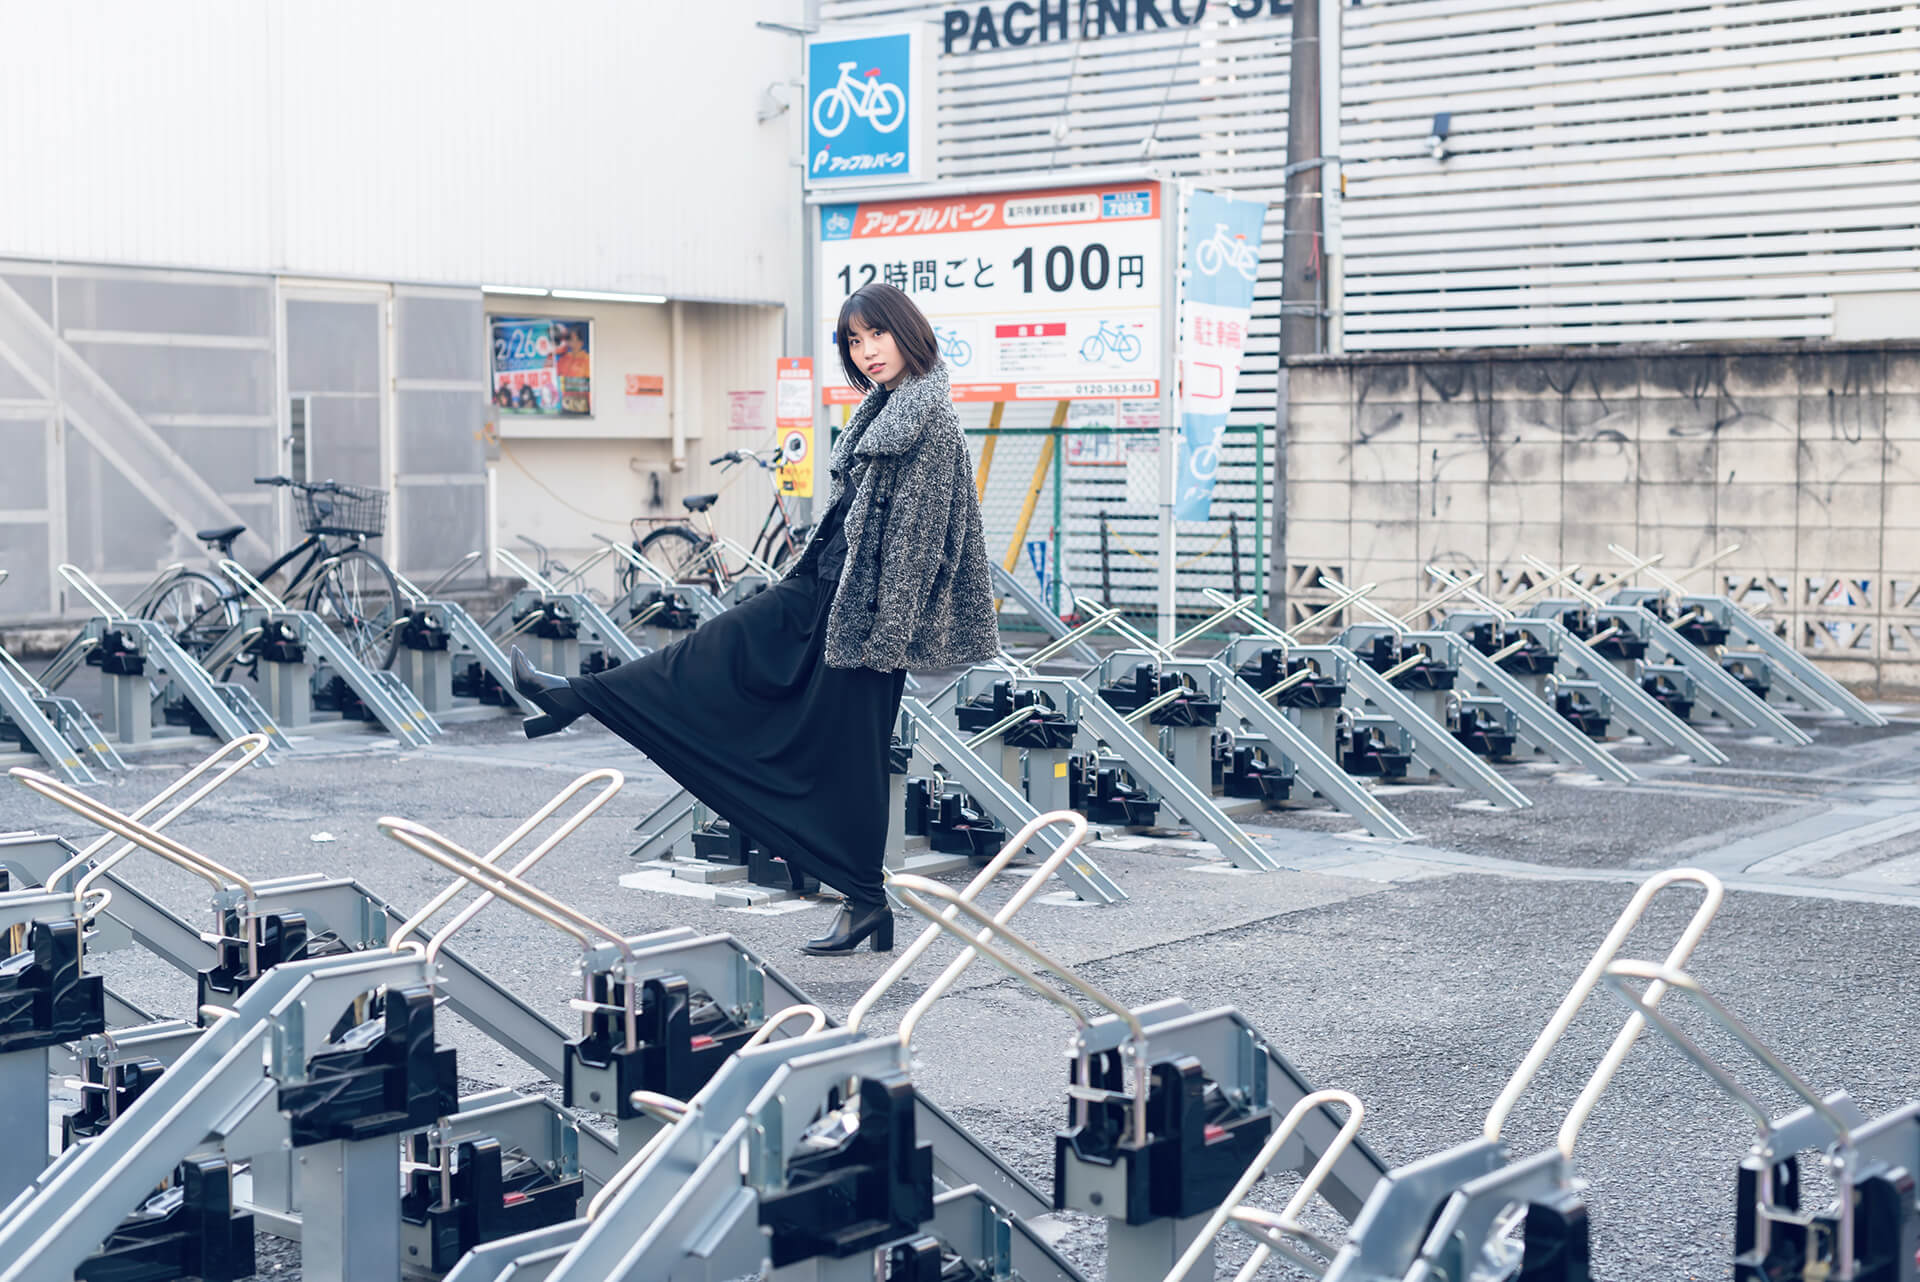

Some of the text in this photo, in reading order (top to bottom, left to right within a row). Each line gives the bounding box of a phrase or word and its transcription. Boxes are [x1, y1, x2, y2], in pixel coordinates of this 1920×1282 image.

[861, 203, 995, 235] アップルパーク
[1012, 243, 1144, 294] 100円
[1076, 383, 1152, 395] 0120-363-863
